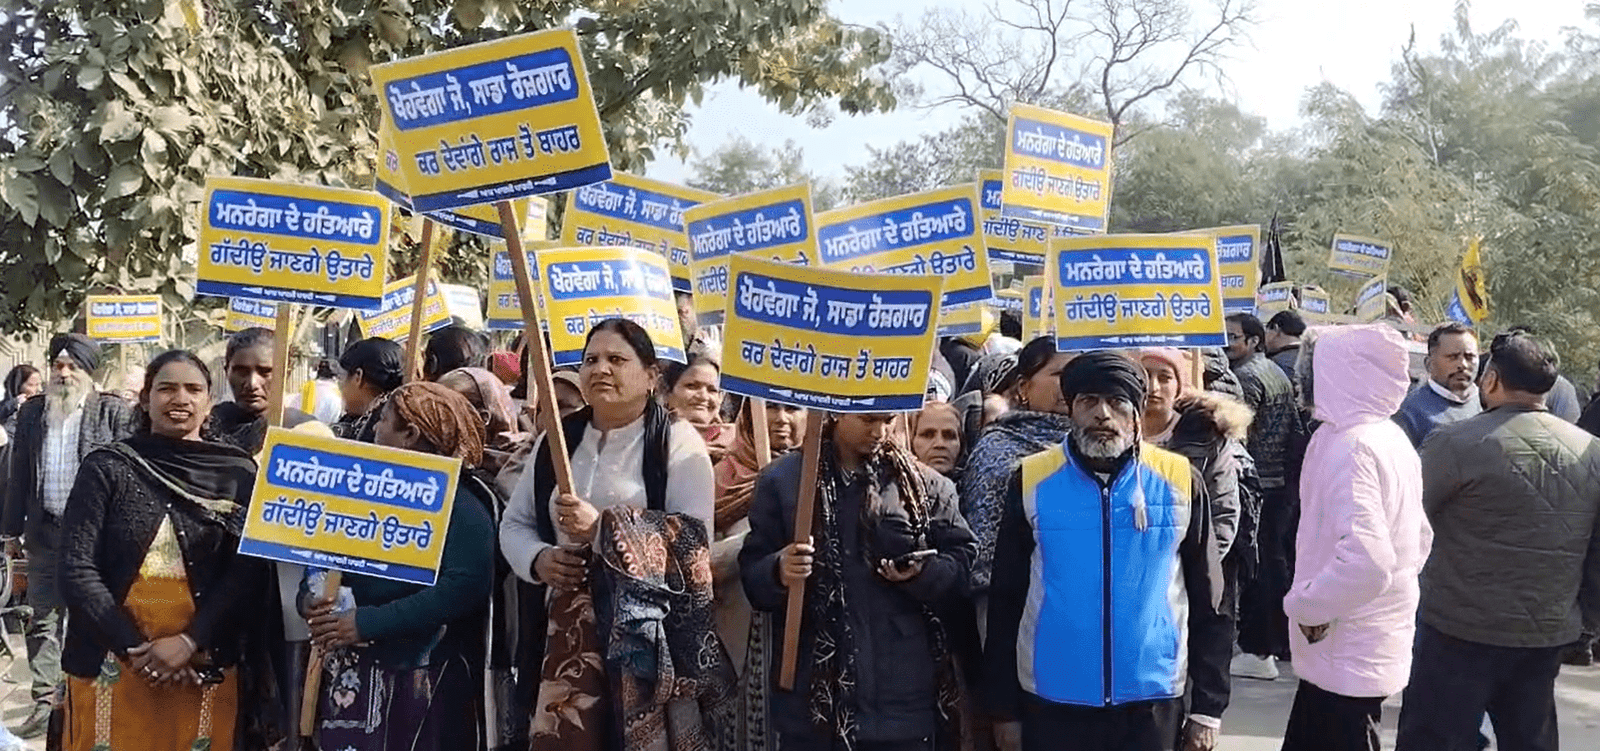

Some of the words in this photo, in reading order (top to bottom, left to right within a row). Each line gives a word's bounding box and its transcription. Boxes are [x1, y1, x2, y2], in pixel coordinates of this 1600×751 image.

[388, 81, 447, 121] ਖੋਹਵੇਗਾ
[445, 73, 472, 115] ਜੋ,
[468, 74, 507, 106] ਸਾਡਾ
[506, 61, 572, 98] ਰੋਜ਼ਗਾਰ
[414, 150, 439, 176] ਕਰ
[440, 133, 487, 172] ਦੇਵਾਂਗੇ
[487, 137, 518, 163] ਰਾਜ
[518, 122, 536, 159] ਤੋਂ
[535, 125, 581, 154] ਬਾਹਰ
[1017, 127, 1057, 156] ਮਨਰੇਗਾ
[1056, 131, 1068, 158] ਦੇ
[1067, 134, 1103, 165] ਹਤਿਆਰੇ
[215, 198, 283, 229] ਮਨਰੇਗਾ
[284, 202, 301, 232] ਦੇ
[302, 206, 375, 239] ਹਤਿਆਰੇ
[641, 199, 669, 221] ਸਾਡਾ
[692, 225, 732, 254] ਮਨਰੇਗਾ
[732, 218, 745, 246] ਦੇ
[745, 207, 801, 245] ਹਤਿਆਰੇ
[577, 226, 595, 245] ਕਰ
[670, 248, 688, 266] ਬਾਹ
[824, 226, 883, 257] ਮਨਰੇਗਾ
[883, 217, 899, 245] ਦੇ
[900, 205, 967, 241] ਹਤਿਆਰੇ
[1217, 240, 1252, 258] ਜ਼ਗਾਰ
[210, 238, 268, 273] ਗੱਦੀਉਂ
[268, 247, 323, 275] ਜਾਣਗੇ
[325, 250, 374, 281] ਉਤਾਰੇ
[551, 263, 601, 293] ਖੋਹਵੇਗਾ
[1065, 254, 1127, 281] ਮਨਰੇਗਾ
[1127, 253, 1144, 279] ਦੇ
[1143, 252, 1206, 280] ਹਤਿਆਰੇ
[739, 276, 801, 318] ਖੋਹਵੇਗਾ
[802, 286, 821, 328] ਜੋ,
[826, 299, 866, 328] ਸਾਡਾ
[867, 293, 928, 328] ਰੋਜ਼ਗਾਰ
[1065, 292, 1118, 323] ਗੱਦੀਉਂ
[1119, 292, 1167, 318] ਜਾਣਗੇ
[1168, 293, 1211, 322] ਉਤਾਰੇ
[564, 316, 585, 334] ਕਰ
[741, 340, 766, 365] ਕਰ
[770, 338, 817, 374] ਦੇਵਾਂਗੇ
[820, 354, 852, 378] ਰਾਜ
[856, 349, 872, 380] ਤੋਂ
[872, 356, 913, 379] ਬਾਹਰ
[275, 455, 346, 490] ਮਨਰੇਗਾ
[346, 463, 364, 494] ਦੇ
[364, 468, 440, 507] ਹਤਿਆਰੇ
[262, 496, 326, 536] ਗੱਦੀਉਂ
[324, 510, 380, 541] ਜਾਣਗੇ
[382, 516, 435, 550] ਉਤਾਰੇ
